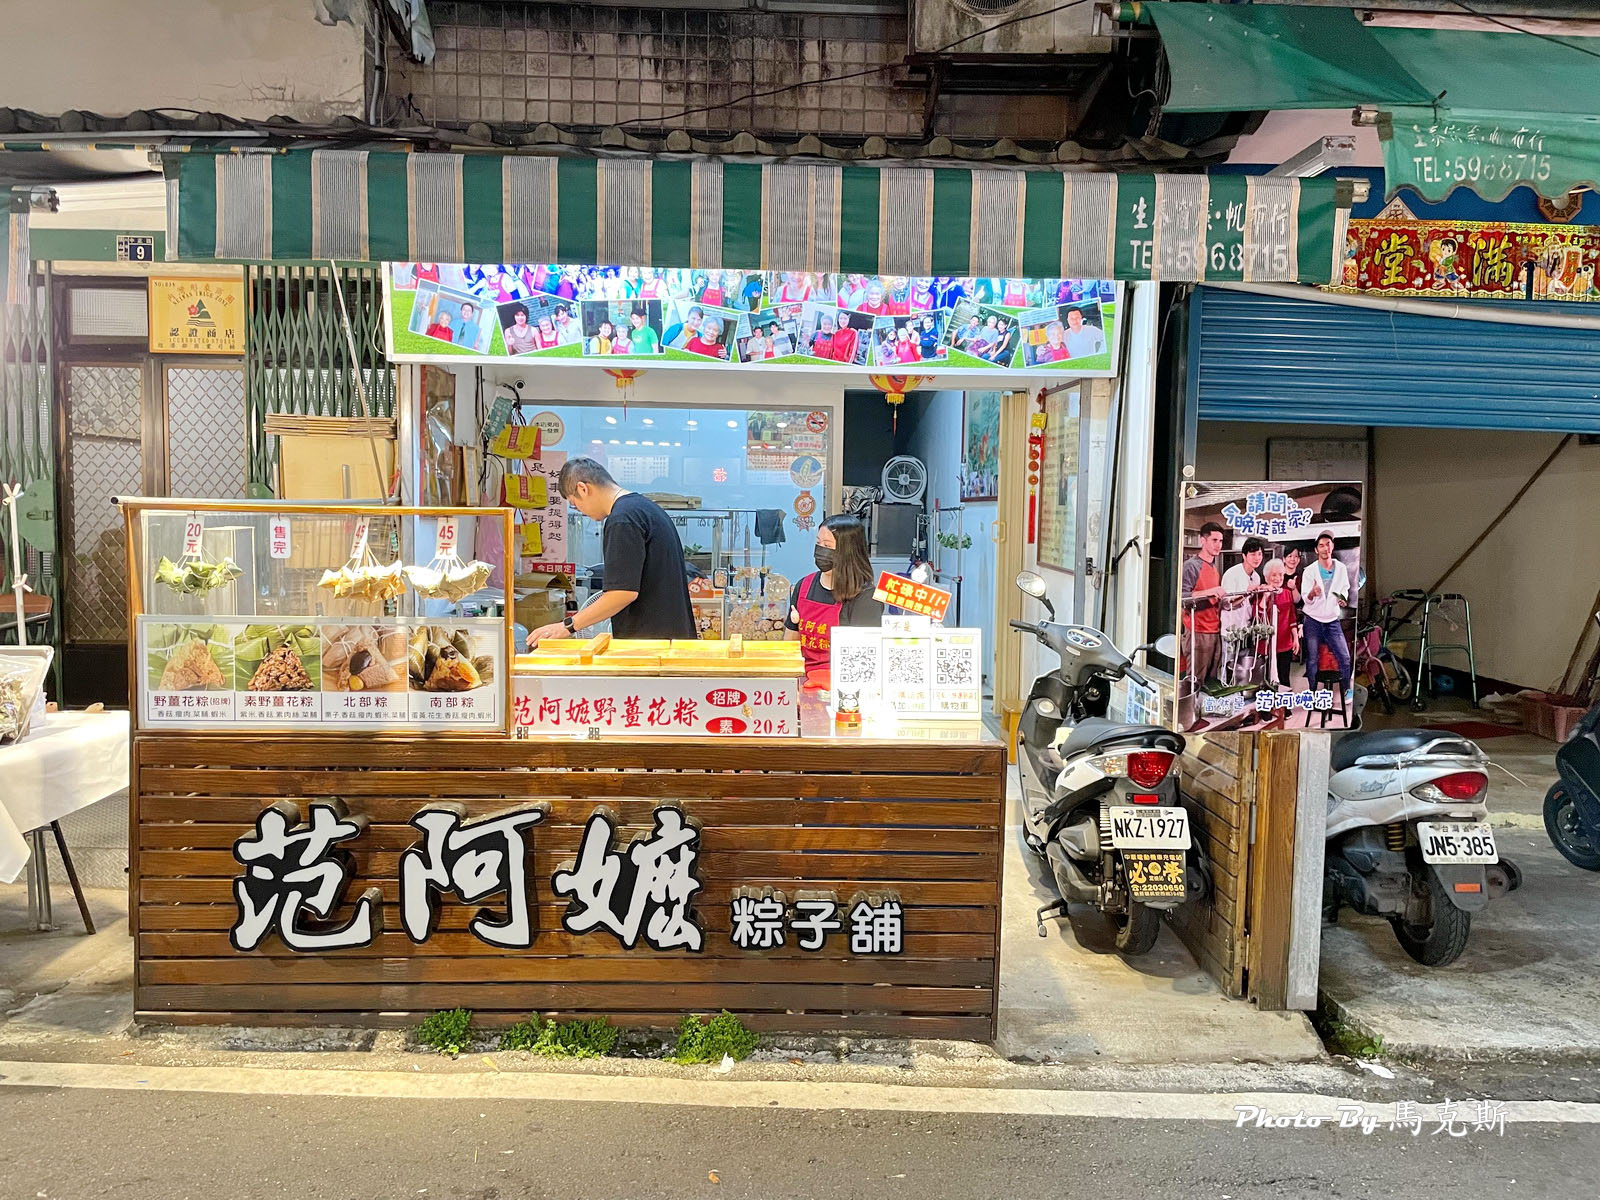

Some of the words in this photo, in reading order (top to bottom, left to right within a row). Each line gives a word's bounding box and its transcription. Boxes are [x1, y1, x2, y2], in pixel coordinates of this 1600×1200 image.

[136, 245, 145, 260] 9
[1373, 232, 1418, 287] 堂
[1247, 491, 1287, 515] 請問
[273, 525, 288, 555] 售完
[438, 525, 455, 541] 45
[243, 695, 314, 708] 素野薑花粽
[343, 696, 389, 708] 北部粽
[429, 696, 475, 709] 南部粽
[711, 690, 742, 706] 招牌
[752, 690, 791, 707] 20元
[1256, 690, 1333, 711] 范阿嬤家
[719, 719, 734, 735] 素
[752, 718, 791, 736] 20元
[234, 803, 704, 952] 范阿嬤
[732, 897, 903, 954] 粽子舖
